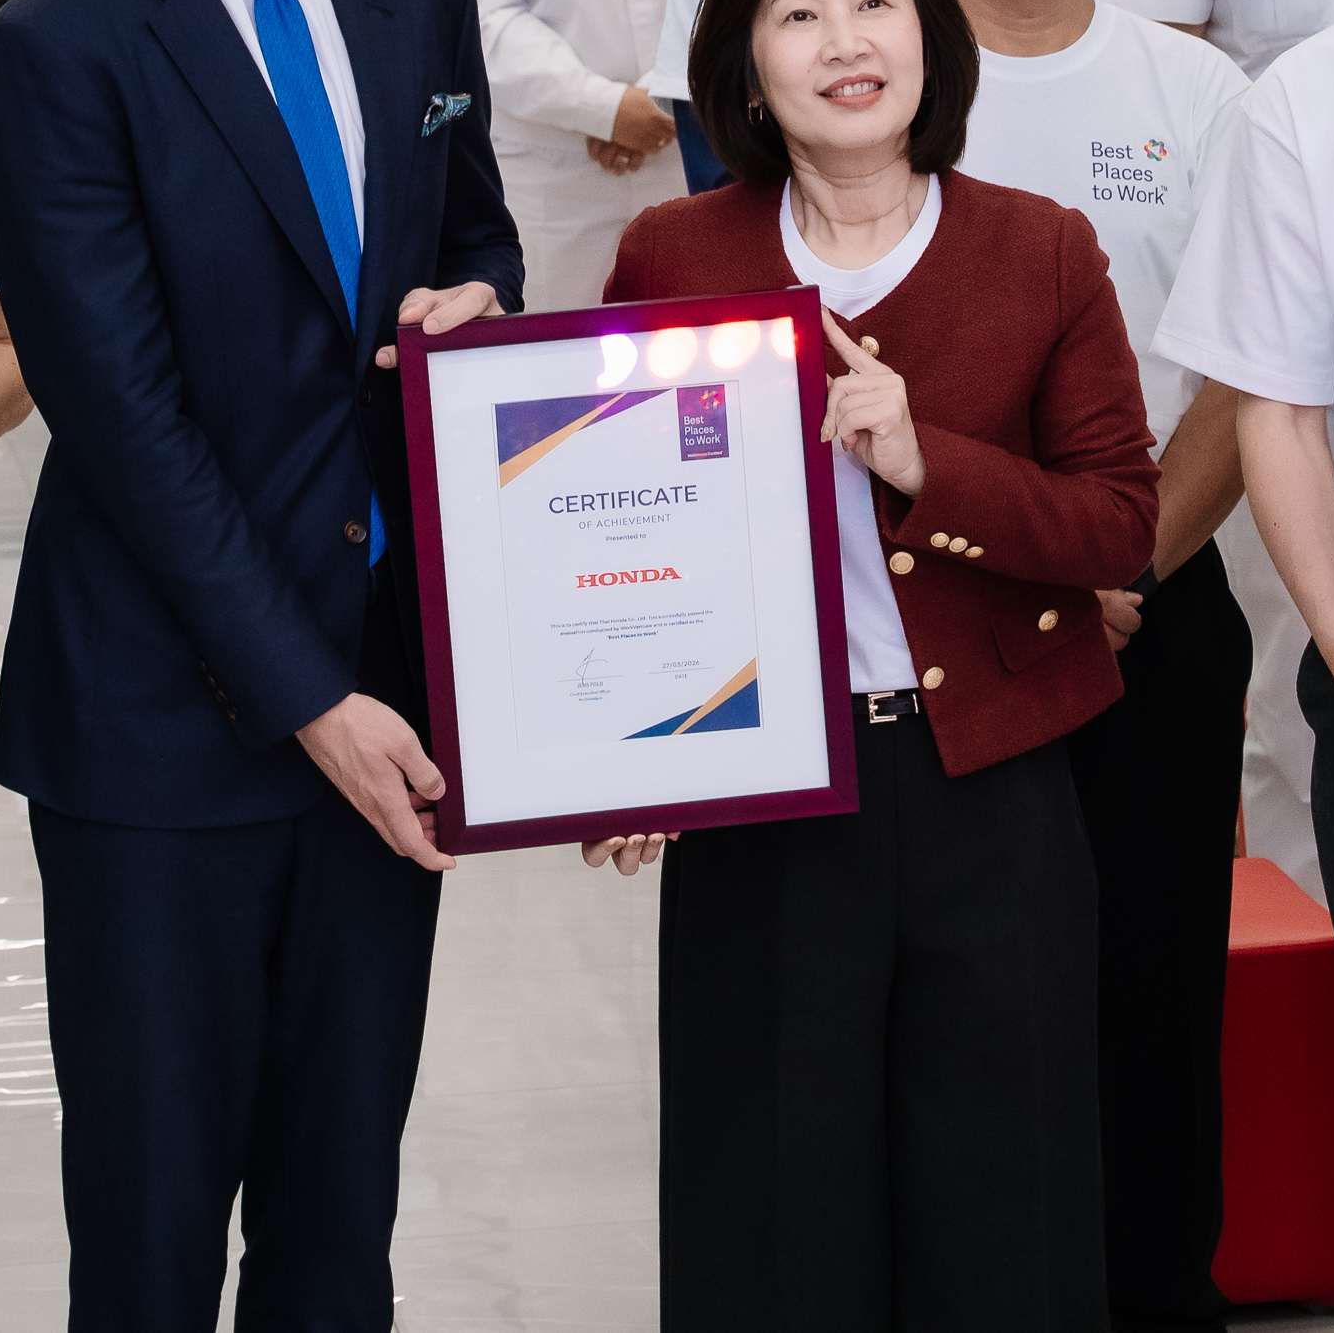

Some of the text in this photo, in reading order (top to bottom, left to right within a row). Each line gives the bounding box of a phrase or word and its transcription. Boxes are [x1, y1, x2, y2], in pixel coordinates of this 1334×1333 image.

[1091, 141, 1133, 160] Best
[1092, 163, 1153, 182] Places
[1092, 185, 1113, 201] to
[683, 416, 704, 425] Best
[685, 426, 714, 435] Places
[685, 438, 695, 446] to
[549, 485, 697, 514] CERTIFICATE
[579, 514, 671, 530] OF ACHIEVEMENT
[605, 533, 638, 542] Presented
[576, 568, 681, 588] HONDA
[662, 660, 700, 669] 27/03/2026
